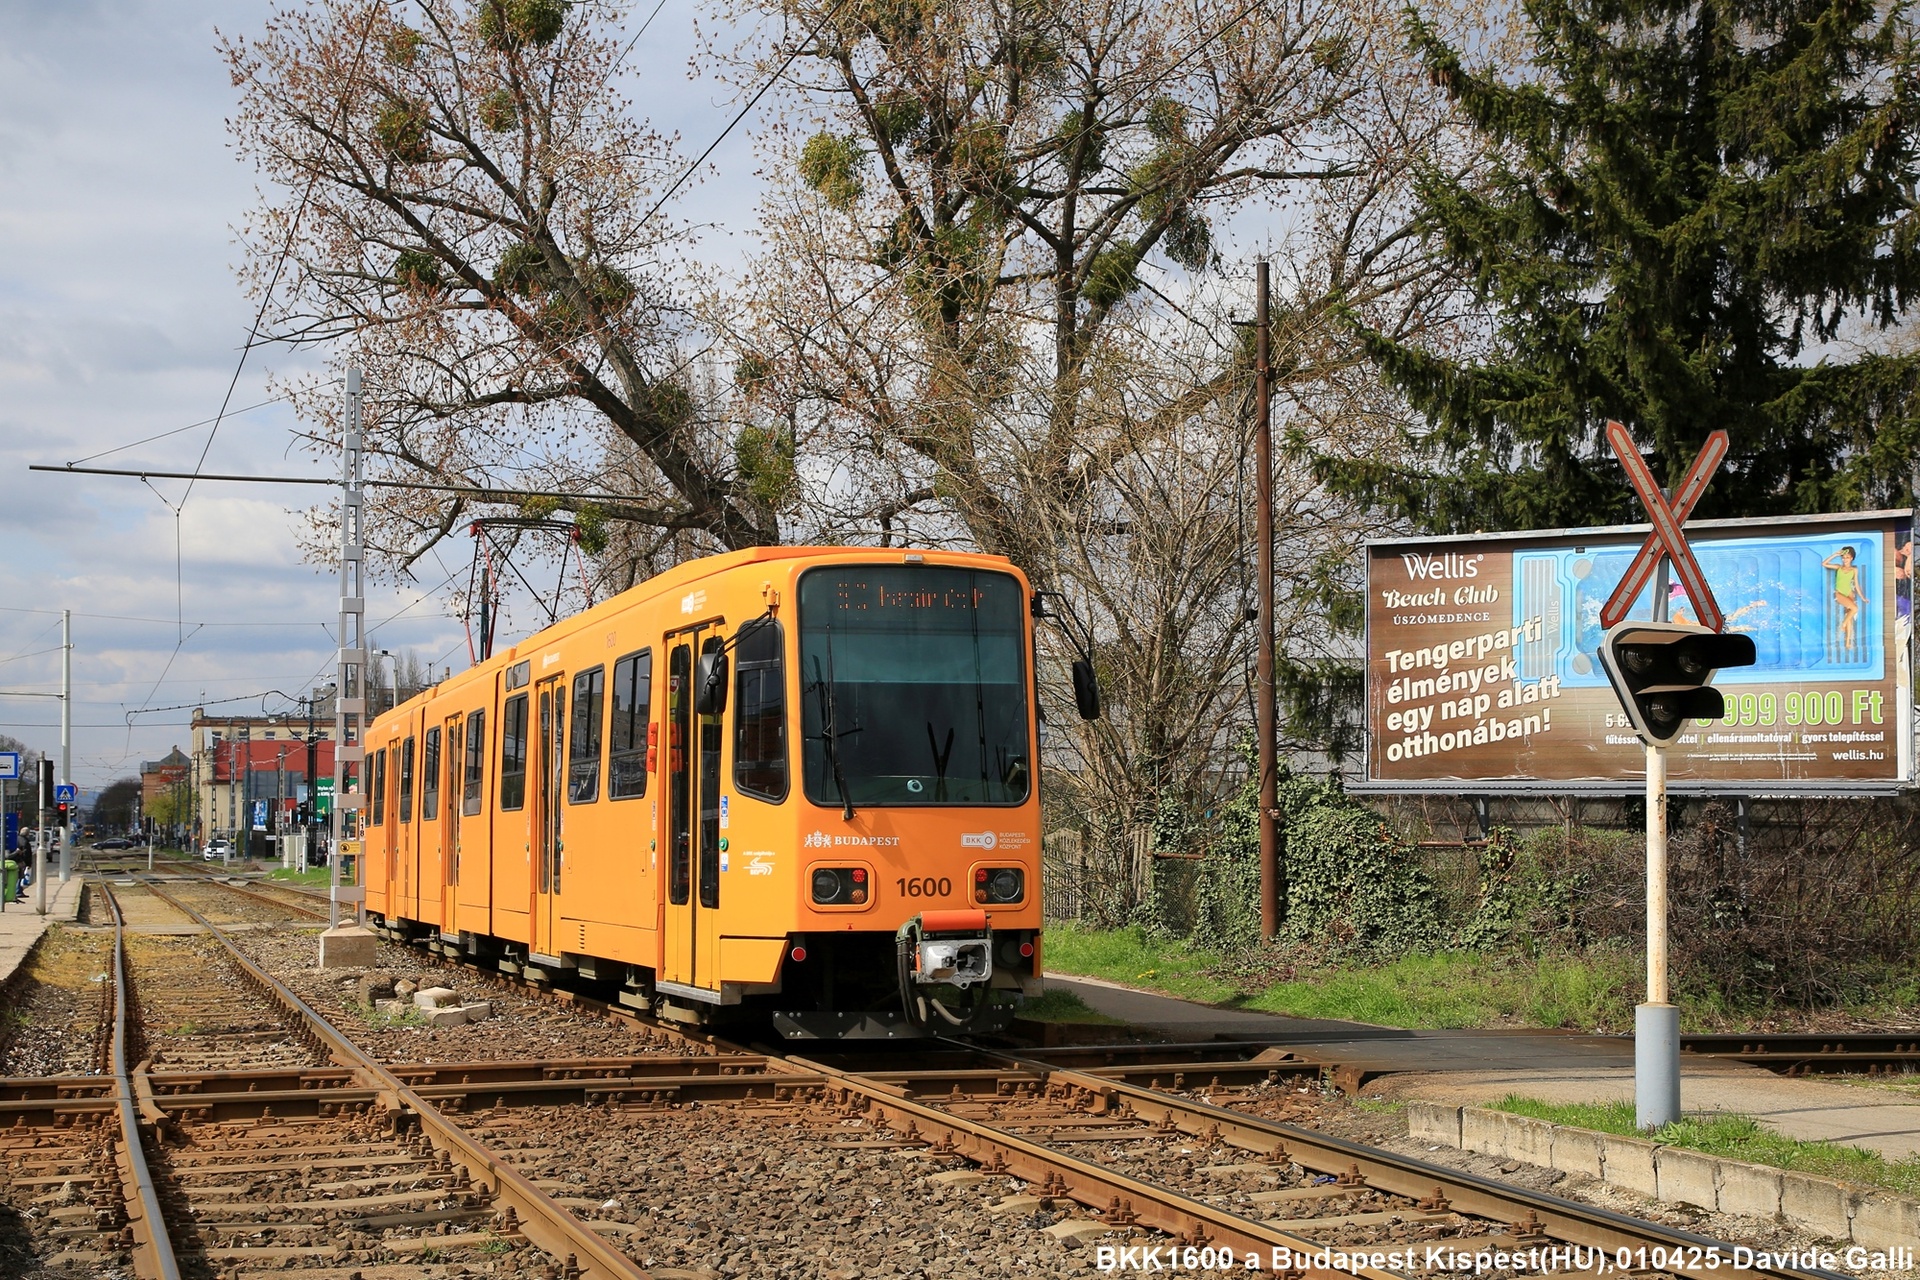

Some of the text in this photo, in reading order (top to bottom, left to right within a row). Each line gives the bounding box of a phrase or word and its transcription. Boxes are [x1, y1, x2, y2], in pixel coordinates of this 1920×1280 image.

[1382, 585, 1499, 609] Beach Club
[1393, 612, 1490, 625] ÚSZÓMEDENCE
[1547, 600, 1560, 635] Wellis
[1385, 615, 1542, 674] Tengerparti
[1387, 655, 1518, 704] élmények
[1386, 674, 1561, 733] egy nap alatt
[1785, 690, 1843, 726] 900
[1852, 689, 1884, 725] Ft
[1386, 707, 1551, 762] otthonában!
[1707, 732, 1792, 744] ellenáramoltatóval
[1801, 733, 1828, 744] gyors
[1829, 731, 1884, 743] telepítéssel
[1832, 749, 1884, 760] wellis.hu
[834, 836, 900, 846] BUDAPEST
[896, 877, 952, 897] 1600
